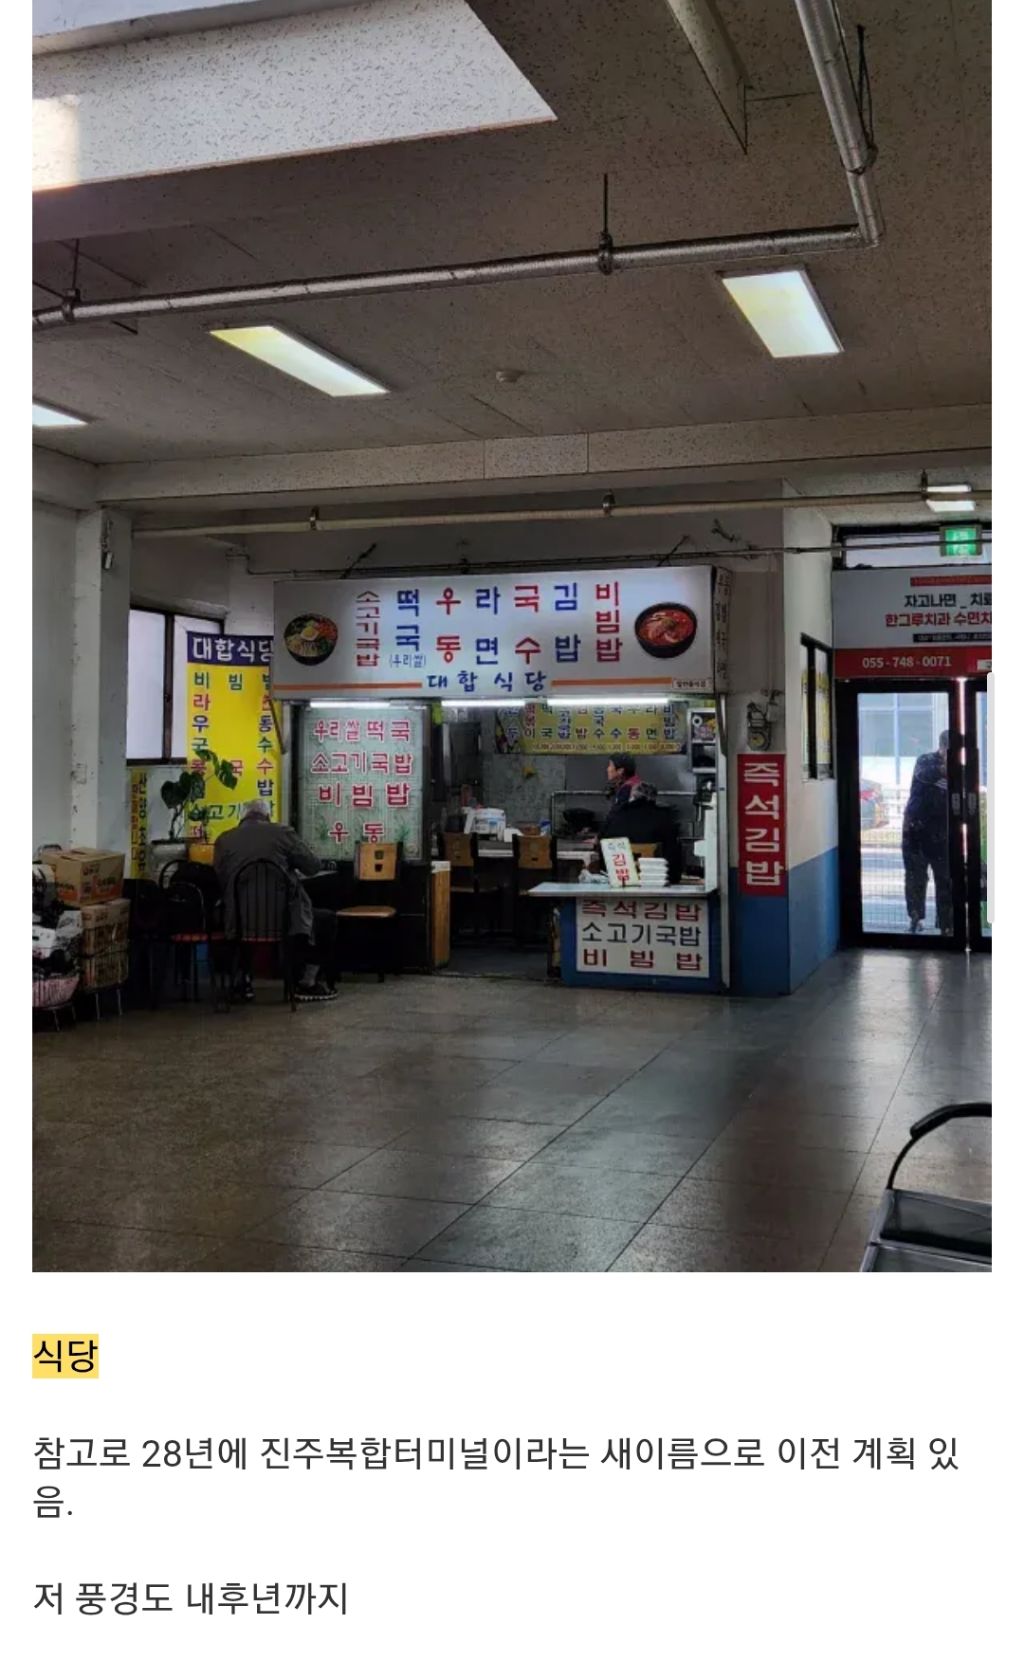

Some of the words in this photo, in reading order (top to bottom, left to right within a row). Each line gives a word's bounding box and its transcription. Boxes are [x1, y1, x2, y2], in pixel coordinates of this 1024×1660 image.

[355, 590, 381, 667] 소고기국밥
[395, 589, 420, 652] 떡국
[436, 587, 461, 663] 우동
[476, 586, 500, 665] 라면
[514, 585, 541, 664] 국수
[553, 582, 581, 664] 김밥
[595, 581, 623, 663] 비빔밥
[885, 613, 951, 627] 한그루치과
[904, 594, 956, 608] 자고나면
[311, 752, 413, 774] 소고기국밥
[318, 782, 410, 807] 비빔밥
[743, 762, 785, 886] 즉석김밥
[582, 922, 702, 946] 소고기국밥
[583, 949, 702, 971] 비빔밥
